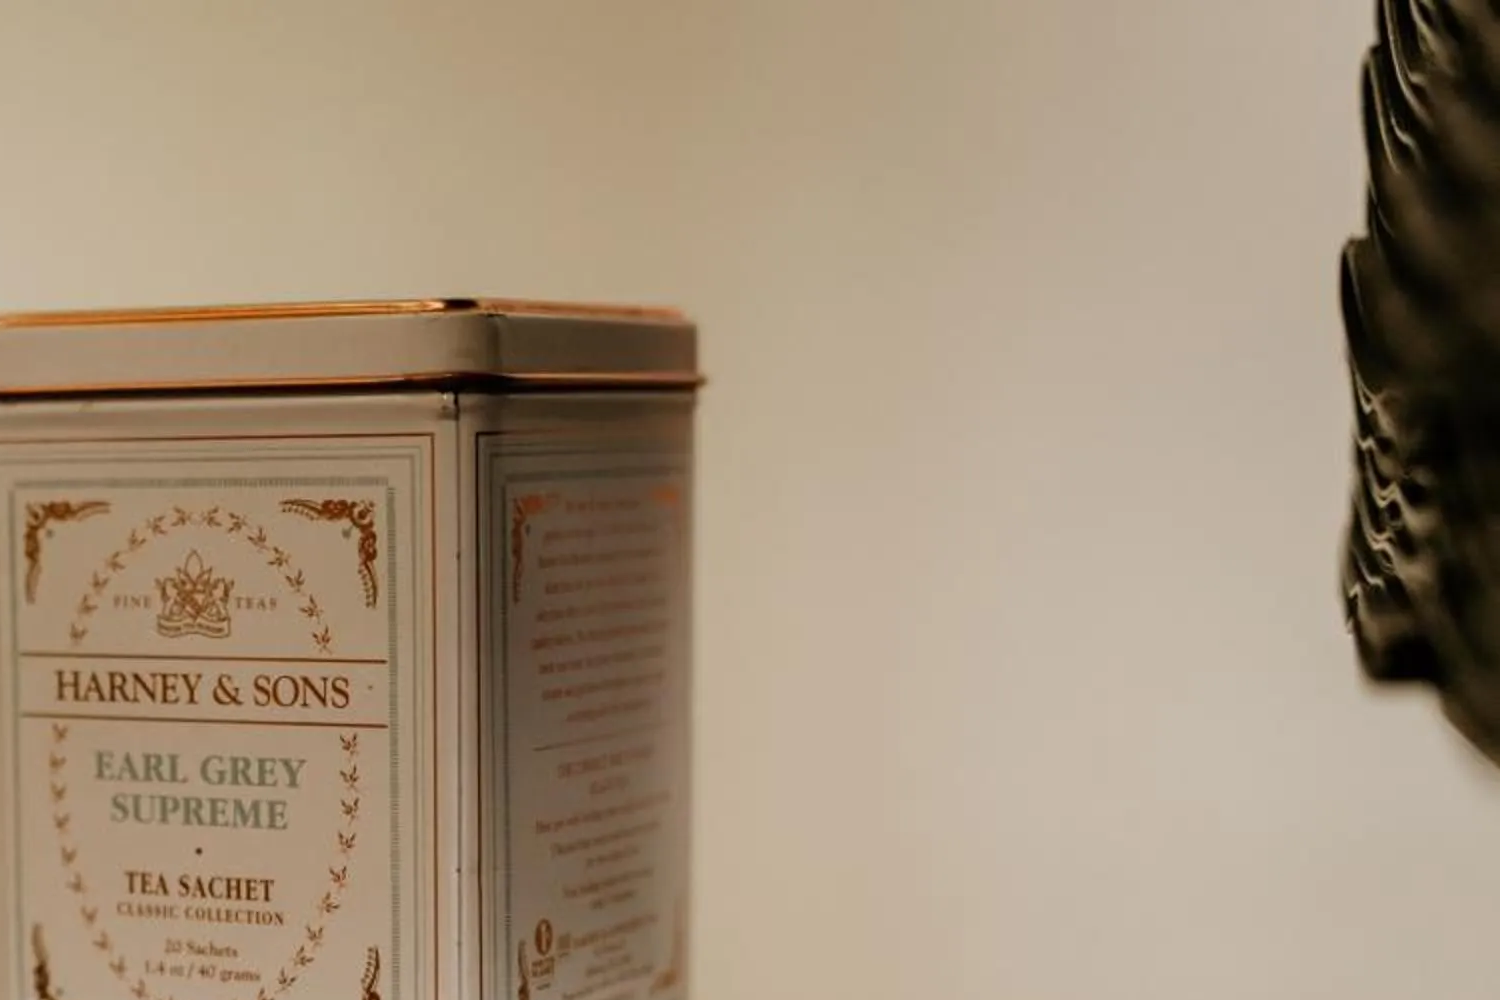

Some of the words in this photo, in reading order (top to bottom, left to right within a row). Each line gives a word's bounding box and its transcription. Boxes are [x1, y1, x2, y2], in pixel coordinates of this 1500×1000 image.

[55, 669, 203, 705] HARNEY
[212, 673, 245, 706] &
[252, 675, 351, 709] SONS
[94, 750, 189, 784] EARL
[199, 754, 308, 789] GREY
[109, 793, 289, 830] SUPREME
[124, 870, 170, 897] TEA
[177, 873, 276, 903] SACHET
[116, 901, 181, 921] CLASSIC
[184, 905, 285, 926] COLLECTION
[219, 968, 262, 984] grams
